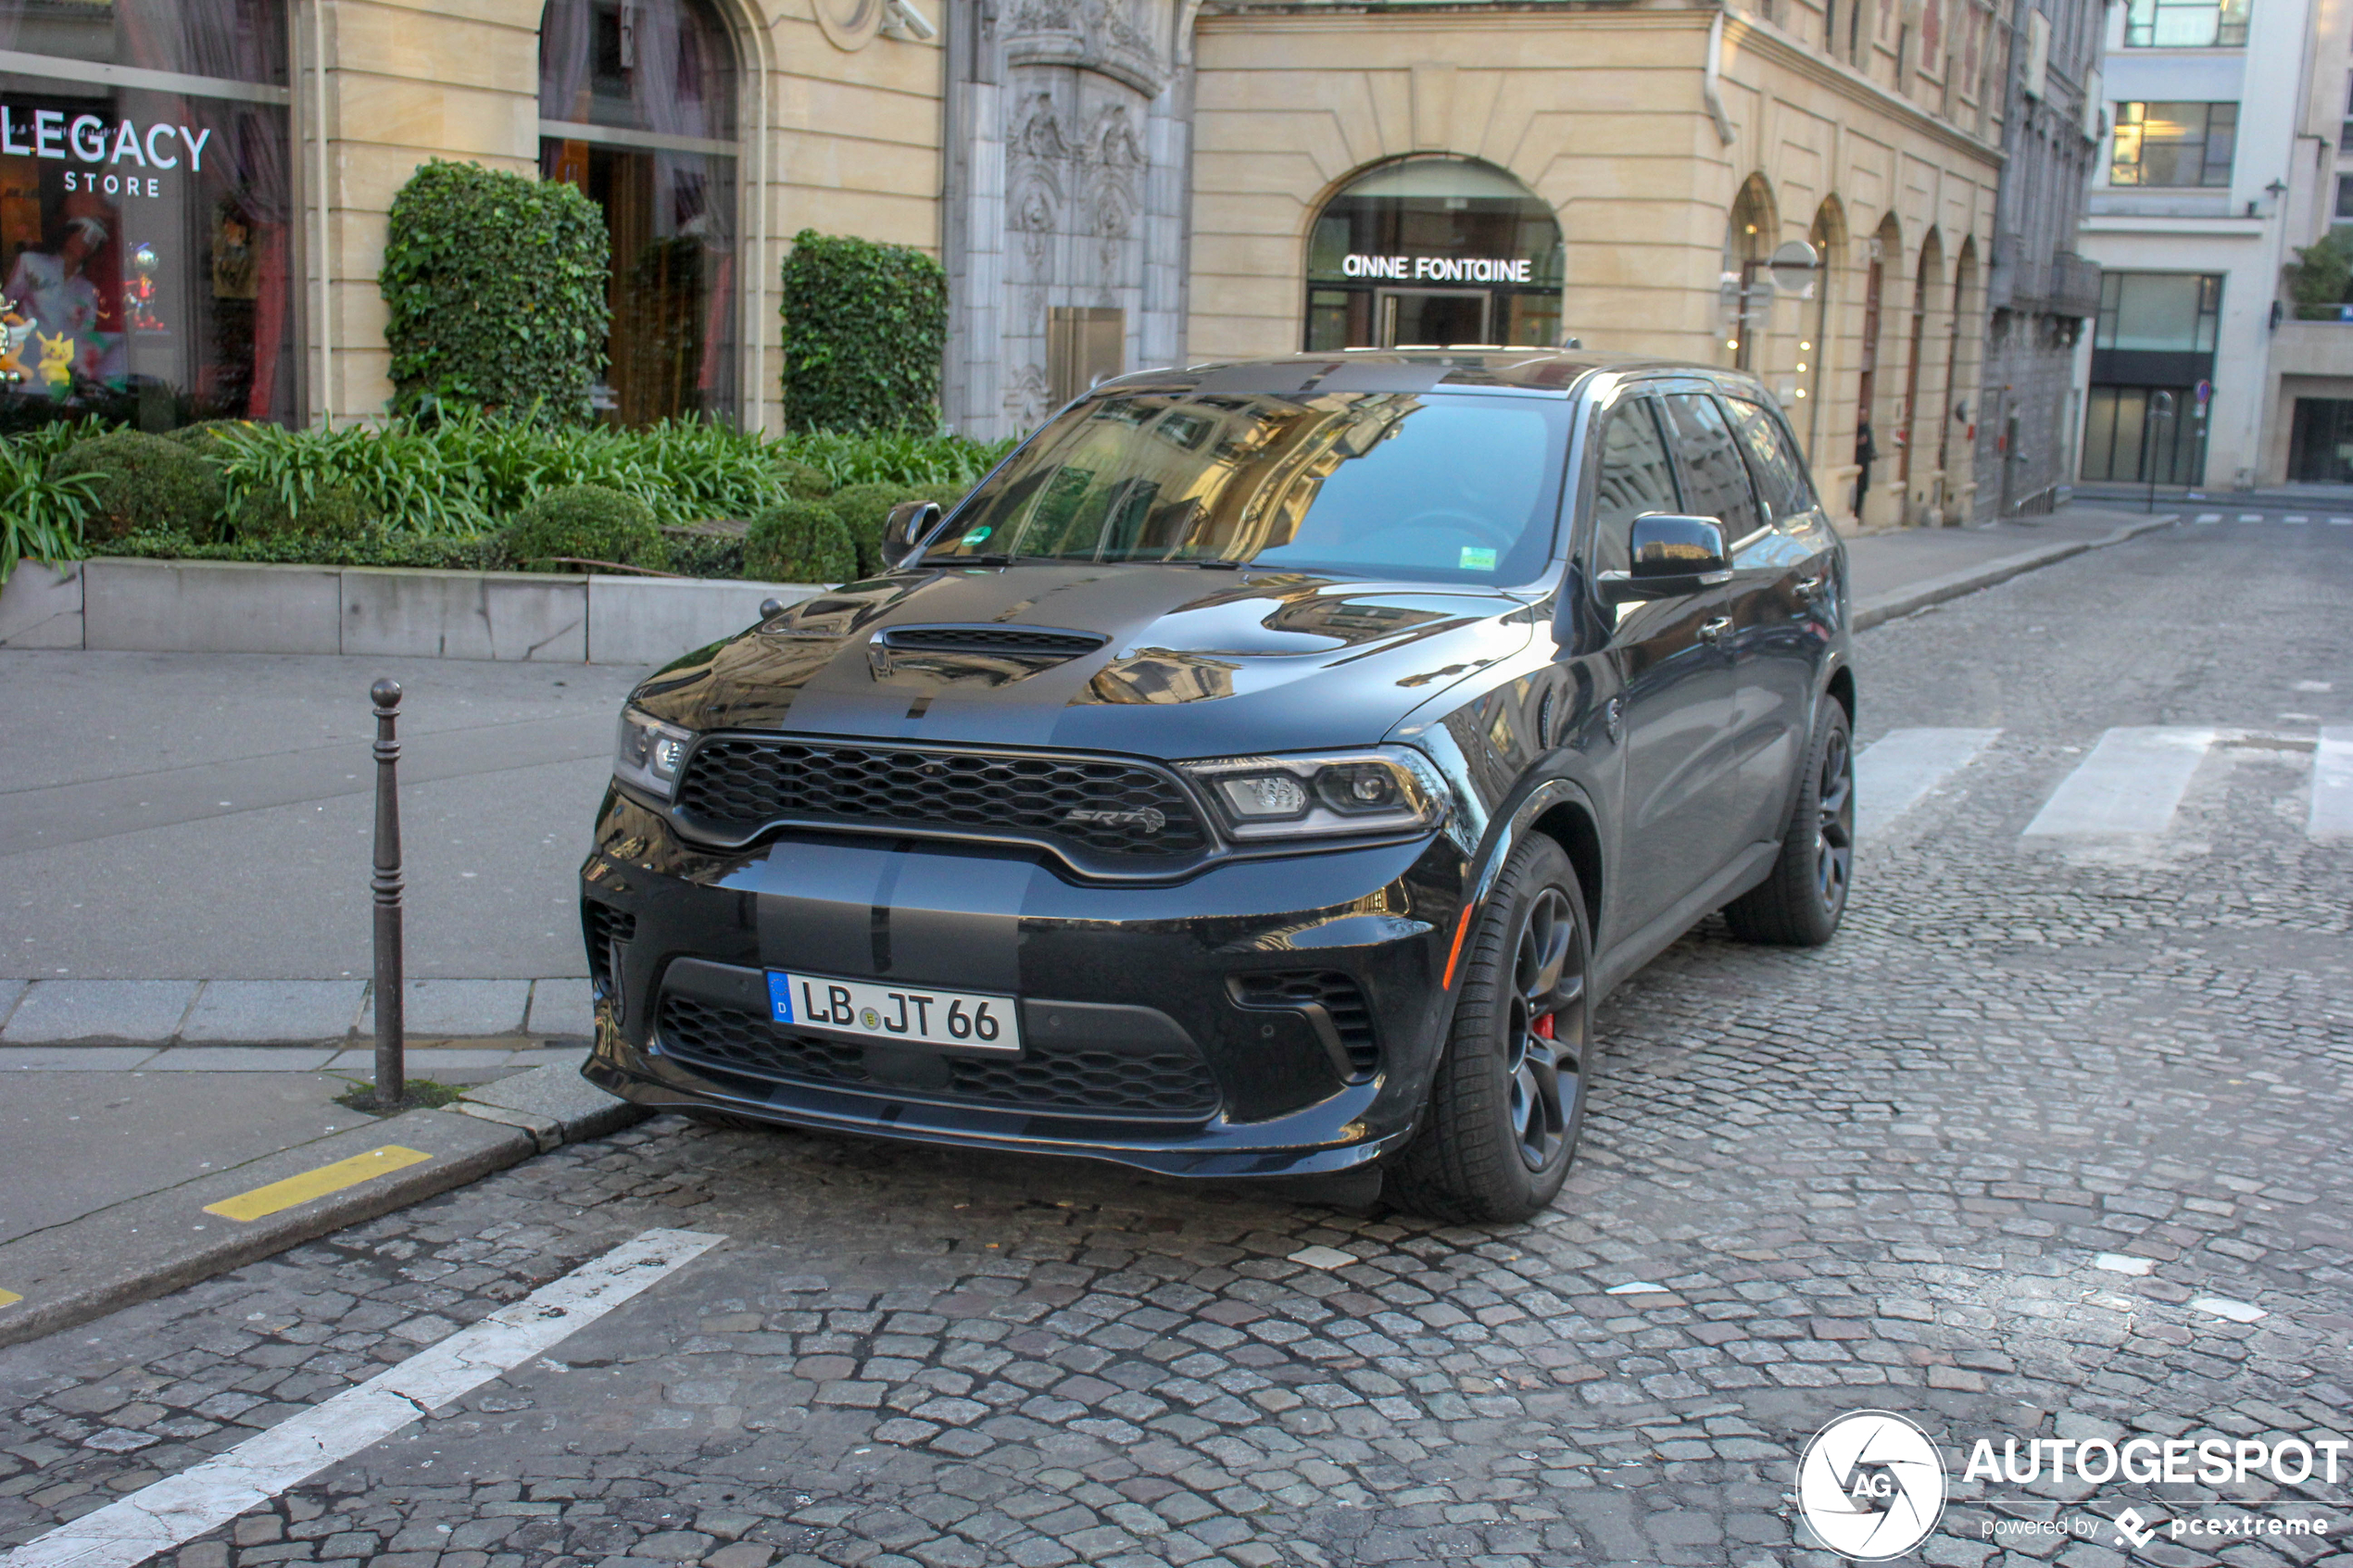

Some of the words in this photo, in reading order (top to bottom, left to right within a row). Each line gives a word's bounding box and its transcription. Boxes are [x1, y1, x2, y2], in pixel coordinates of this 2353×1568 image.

[1, 105, 211, 172] LEGACY
[64, 170, 159, 198] STORE
[1066, 809, 1145, 826] SRT
[777, 1002, 786, 1013] D
[802, 981, 855, 1025] LB
[884, 992, 934, 1035] JT
[948, 999, 1000, 1041] 66
